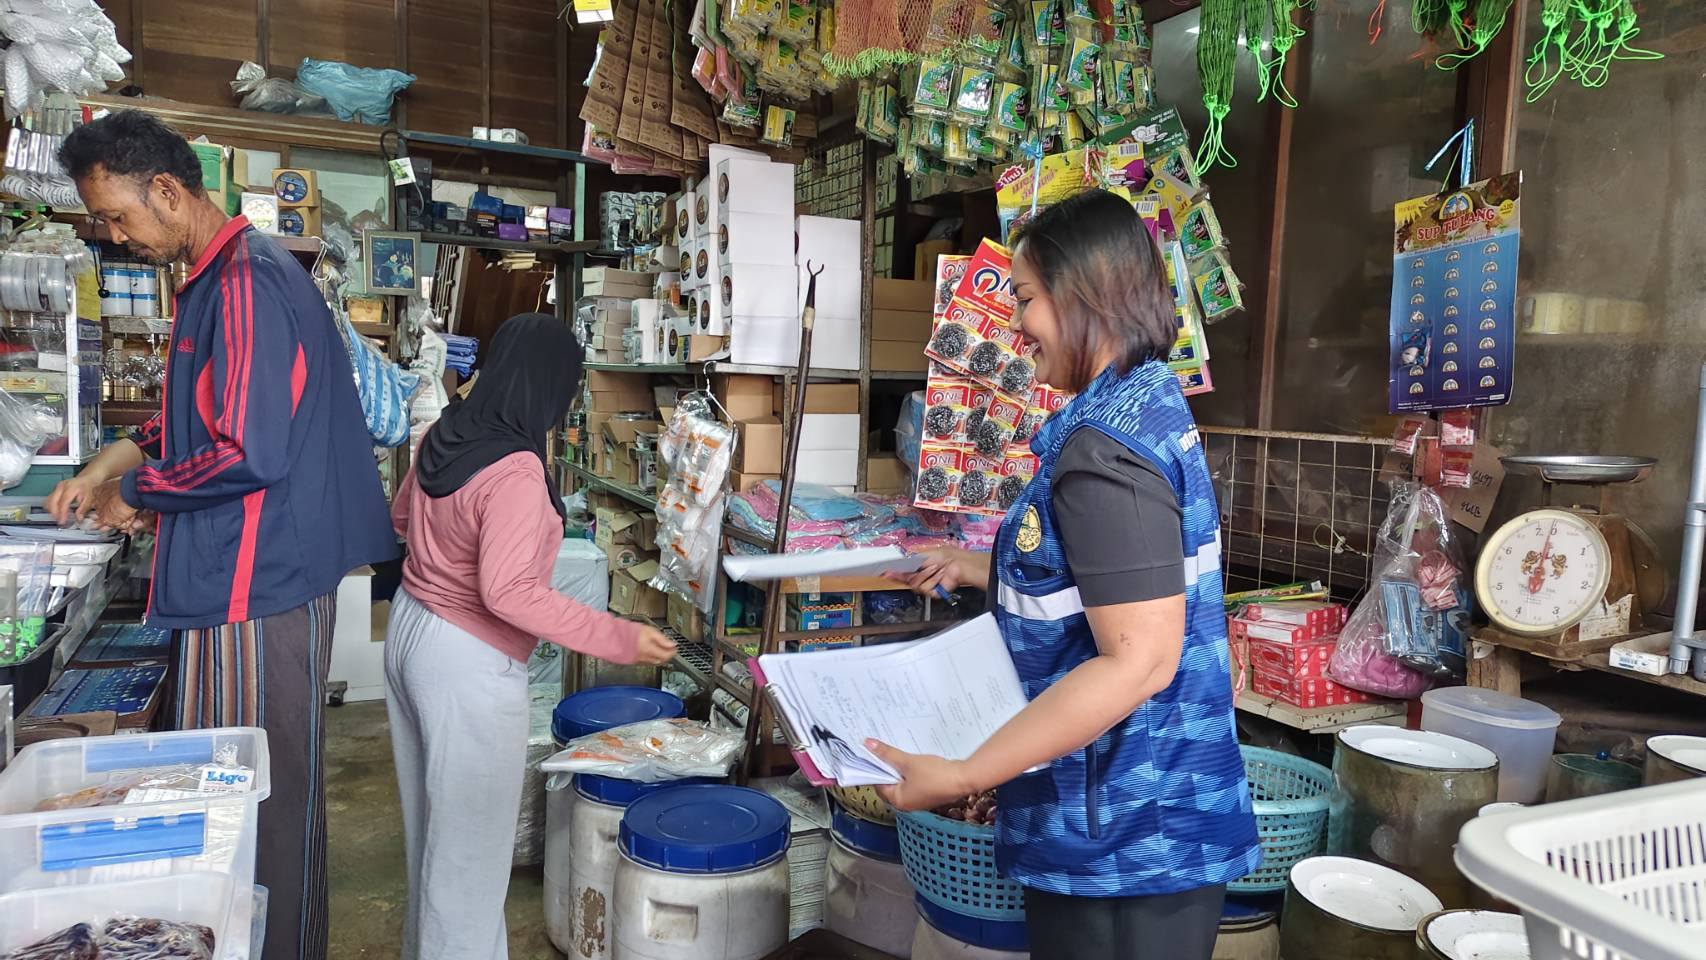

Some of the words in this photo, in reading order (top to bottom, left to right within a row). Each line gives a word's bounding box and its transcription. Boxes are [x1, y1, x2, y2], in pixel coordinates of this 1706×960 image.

[1417, 226, 1441, 240] SUP
[1442, 208, 1495, 233] TULANG
[932, 390, 963, 404] ONE
[925, 454, 957, 468] ONE
[1505, 546, 1513, 555] 6
[1552, 606, 1560, 615] 3
[206, 771, 247, 785] Ligo
